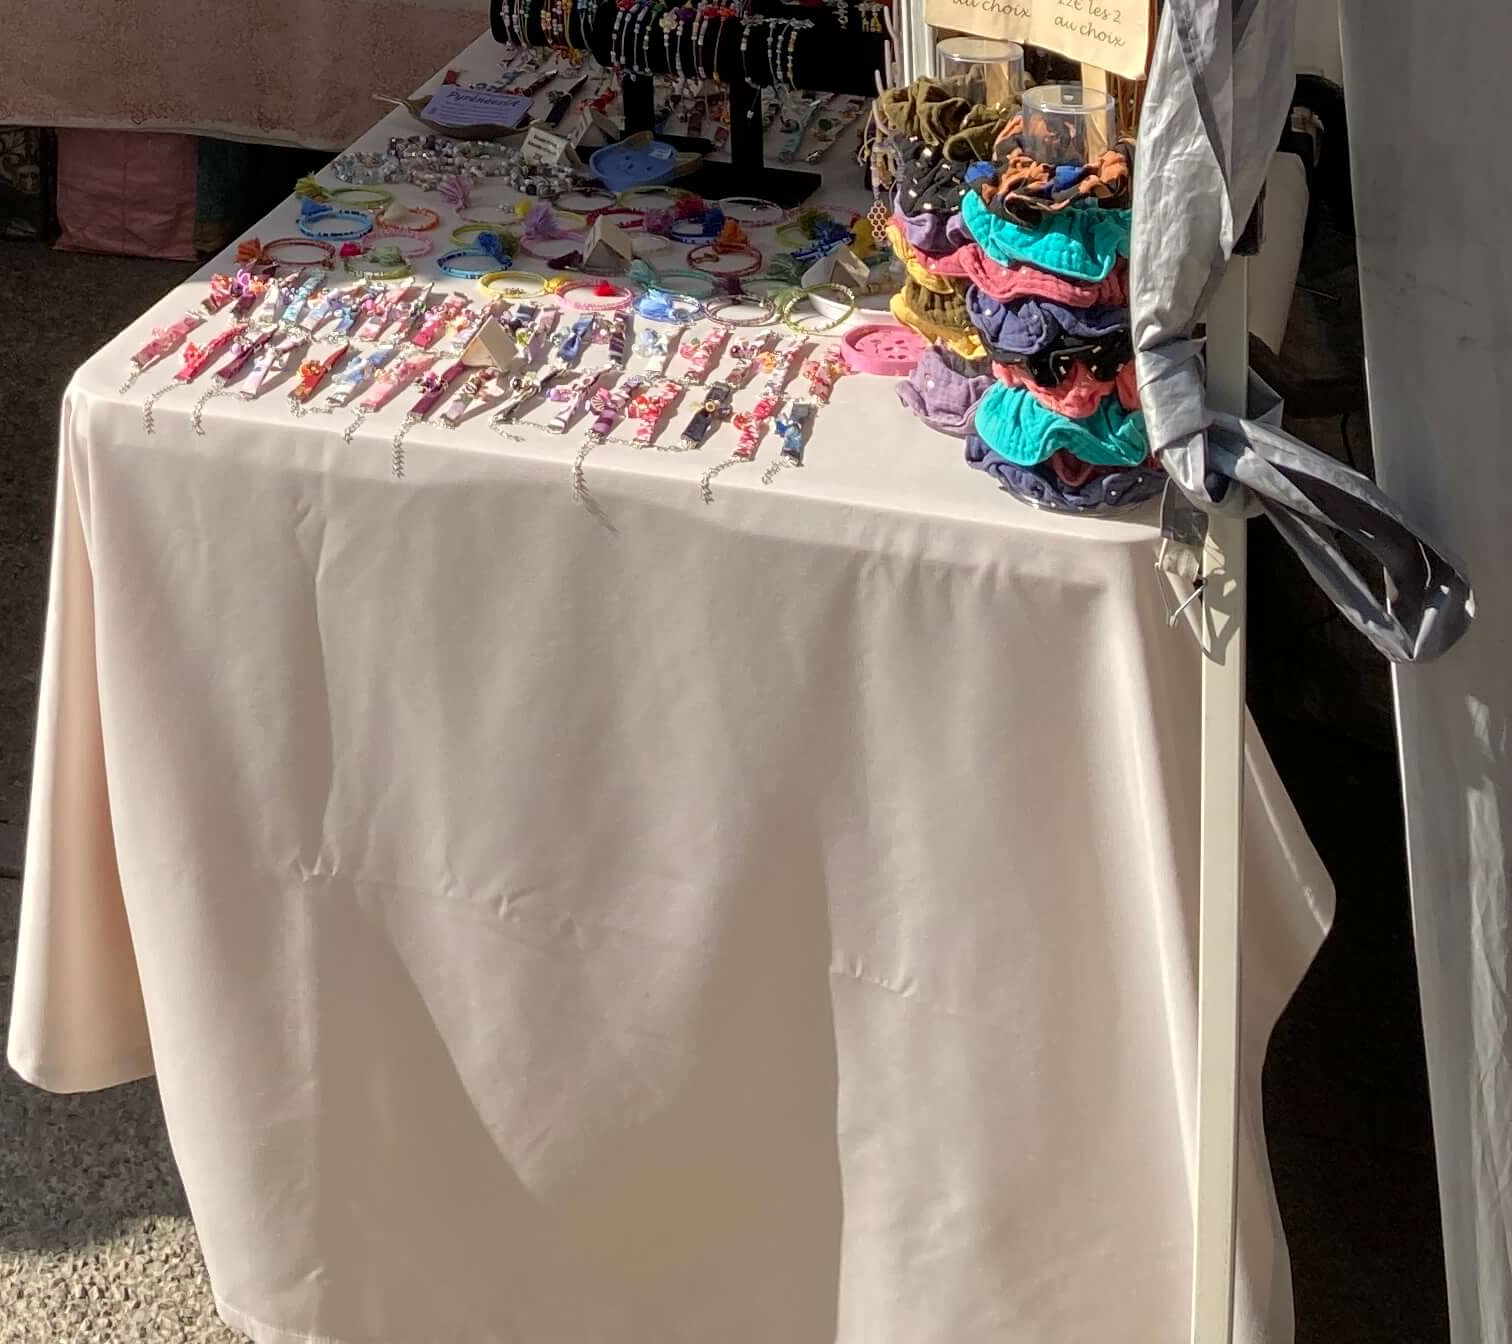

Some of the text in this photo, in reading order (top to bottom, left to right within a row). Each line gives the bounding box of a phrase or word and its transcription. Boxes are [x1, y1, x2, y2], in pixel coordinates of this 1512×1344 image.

[1088, 0, 1109, 21] les
[1113, 9, 1122, 24] 2
[1054, 14, 1126, 48] au choix
